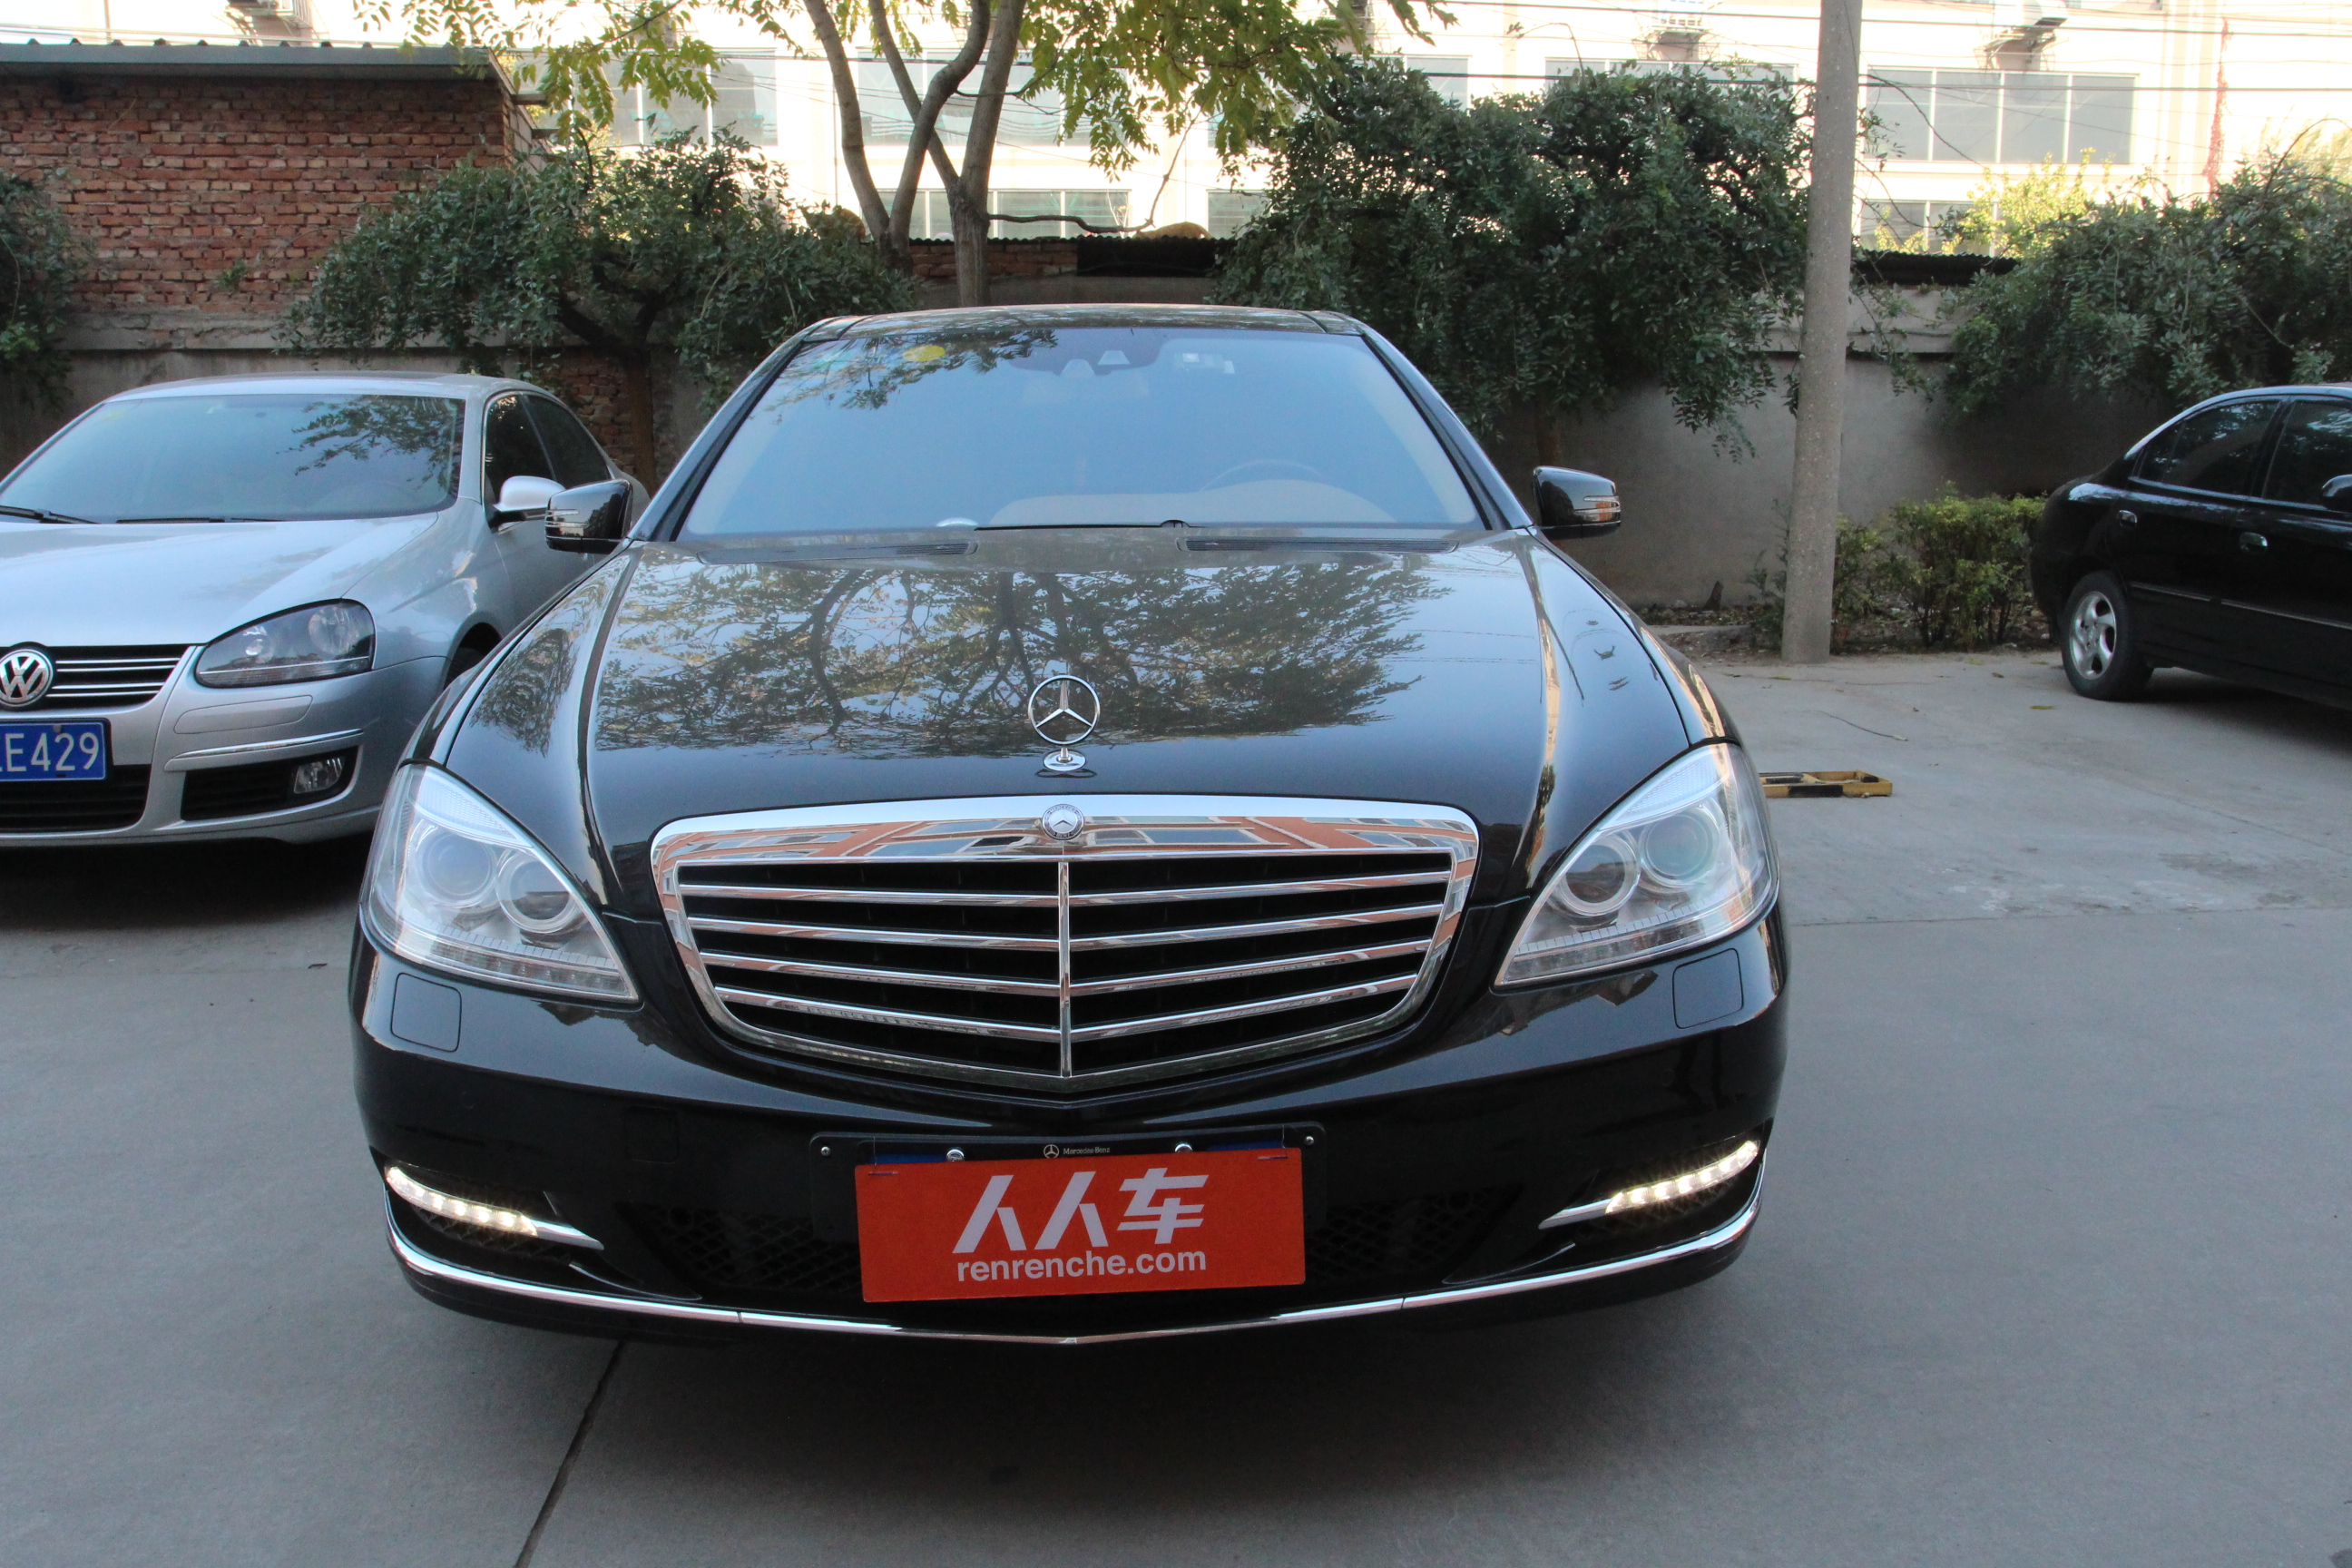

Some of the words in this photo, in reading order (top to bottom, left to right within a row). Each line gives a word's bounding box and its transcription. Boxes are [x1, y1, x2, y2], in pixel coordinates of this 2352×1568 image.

[0, 732, 100, 772] E429
[953, 1168, 1209, 1253] 人人车
[957, 1250, 1206, 1281] renrenche.com
